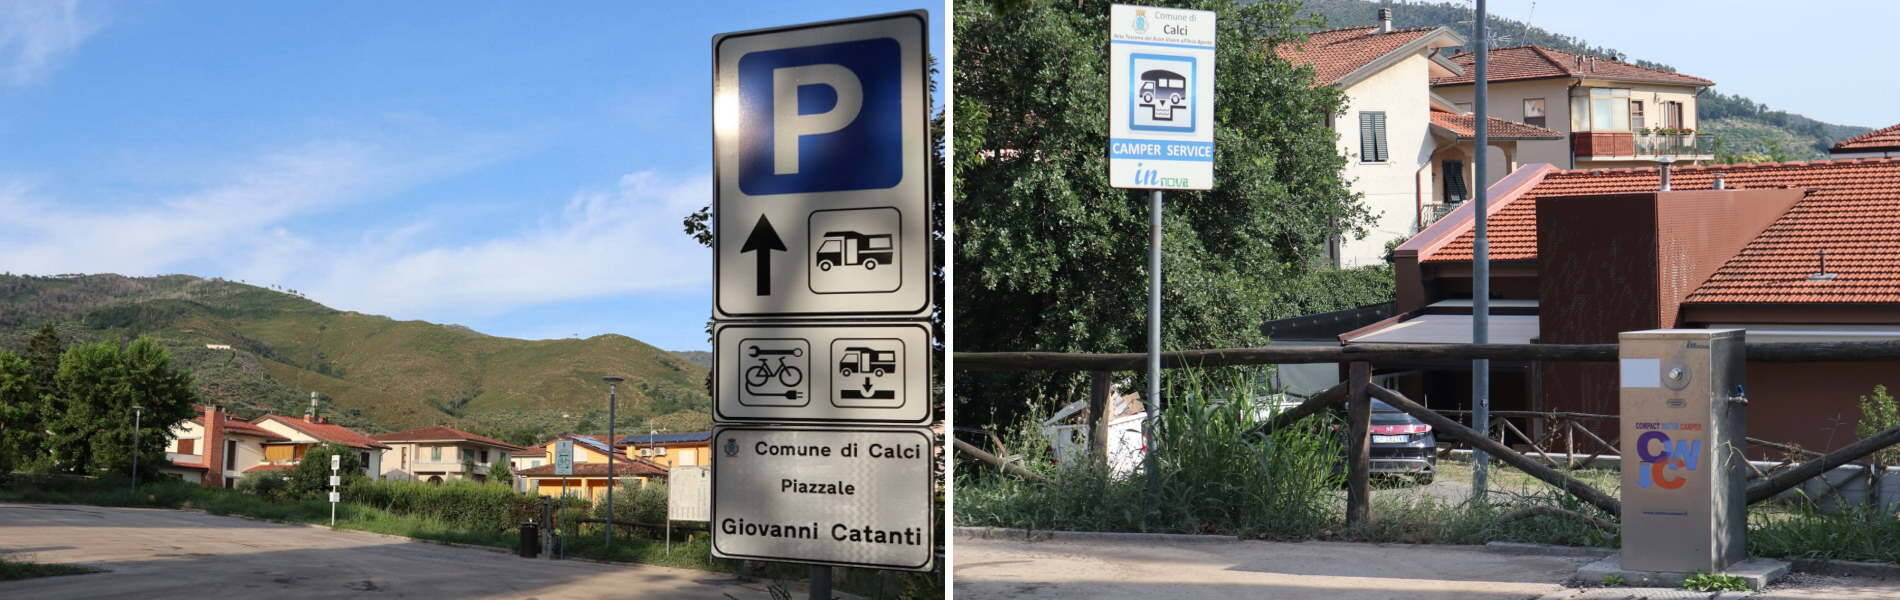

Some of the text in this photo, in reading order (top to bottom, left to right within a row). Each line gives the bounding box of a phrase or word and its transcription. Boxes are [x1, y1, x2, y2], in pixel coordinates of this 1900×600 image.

[1154, 11, 1198, 22] Comune di
[1163, 24, 1188, 36] Calci
[773, 63, 864, 176] P
[1112, 142, 1212, 158] CAMPER SERVICE
[755, 441, 921, 459] Comune di Calci
[781, 478, 855, 495] Piazzale
[721, 518, 921, 546] Giovanni Catanti
